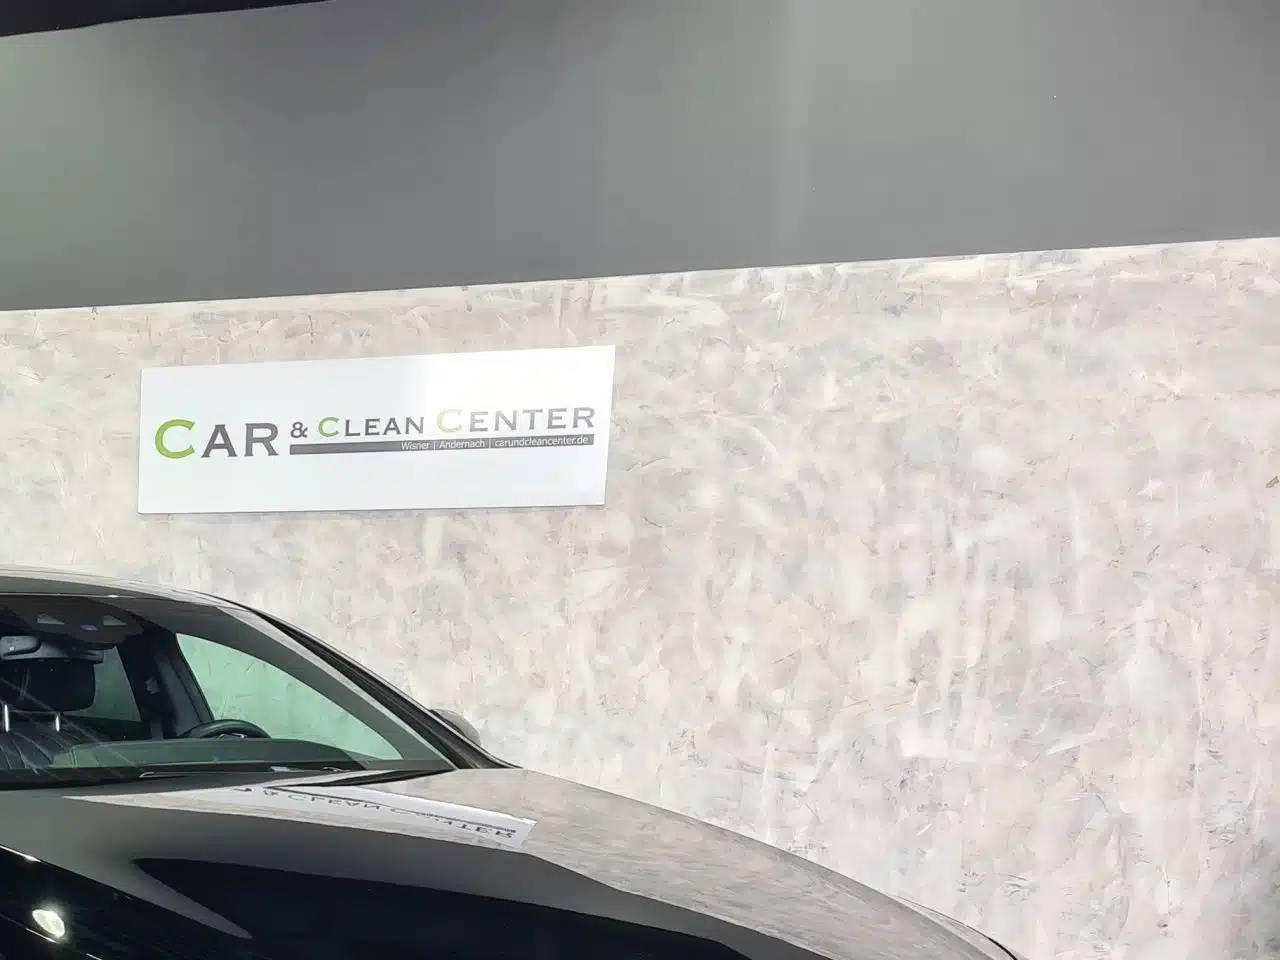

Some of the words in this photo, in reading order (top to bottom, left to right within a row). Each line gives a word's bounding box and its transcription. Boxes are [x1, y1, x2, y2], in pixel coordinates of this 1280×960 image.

[155, 419, 278, 459] CAR
[290, 421, 308, 438] &
[318, 416, 424, 438] CLEAN
[436, 407, 595, 433] CENTER
[401, 441, 430, 450] Wisner
[439, 439, 486, 449] Andernach
[494, 436, 589, 447] carundcleancenter.de
